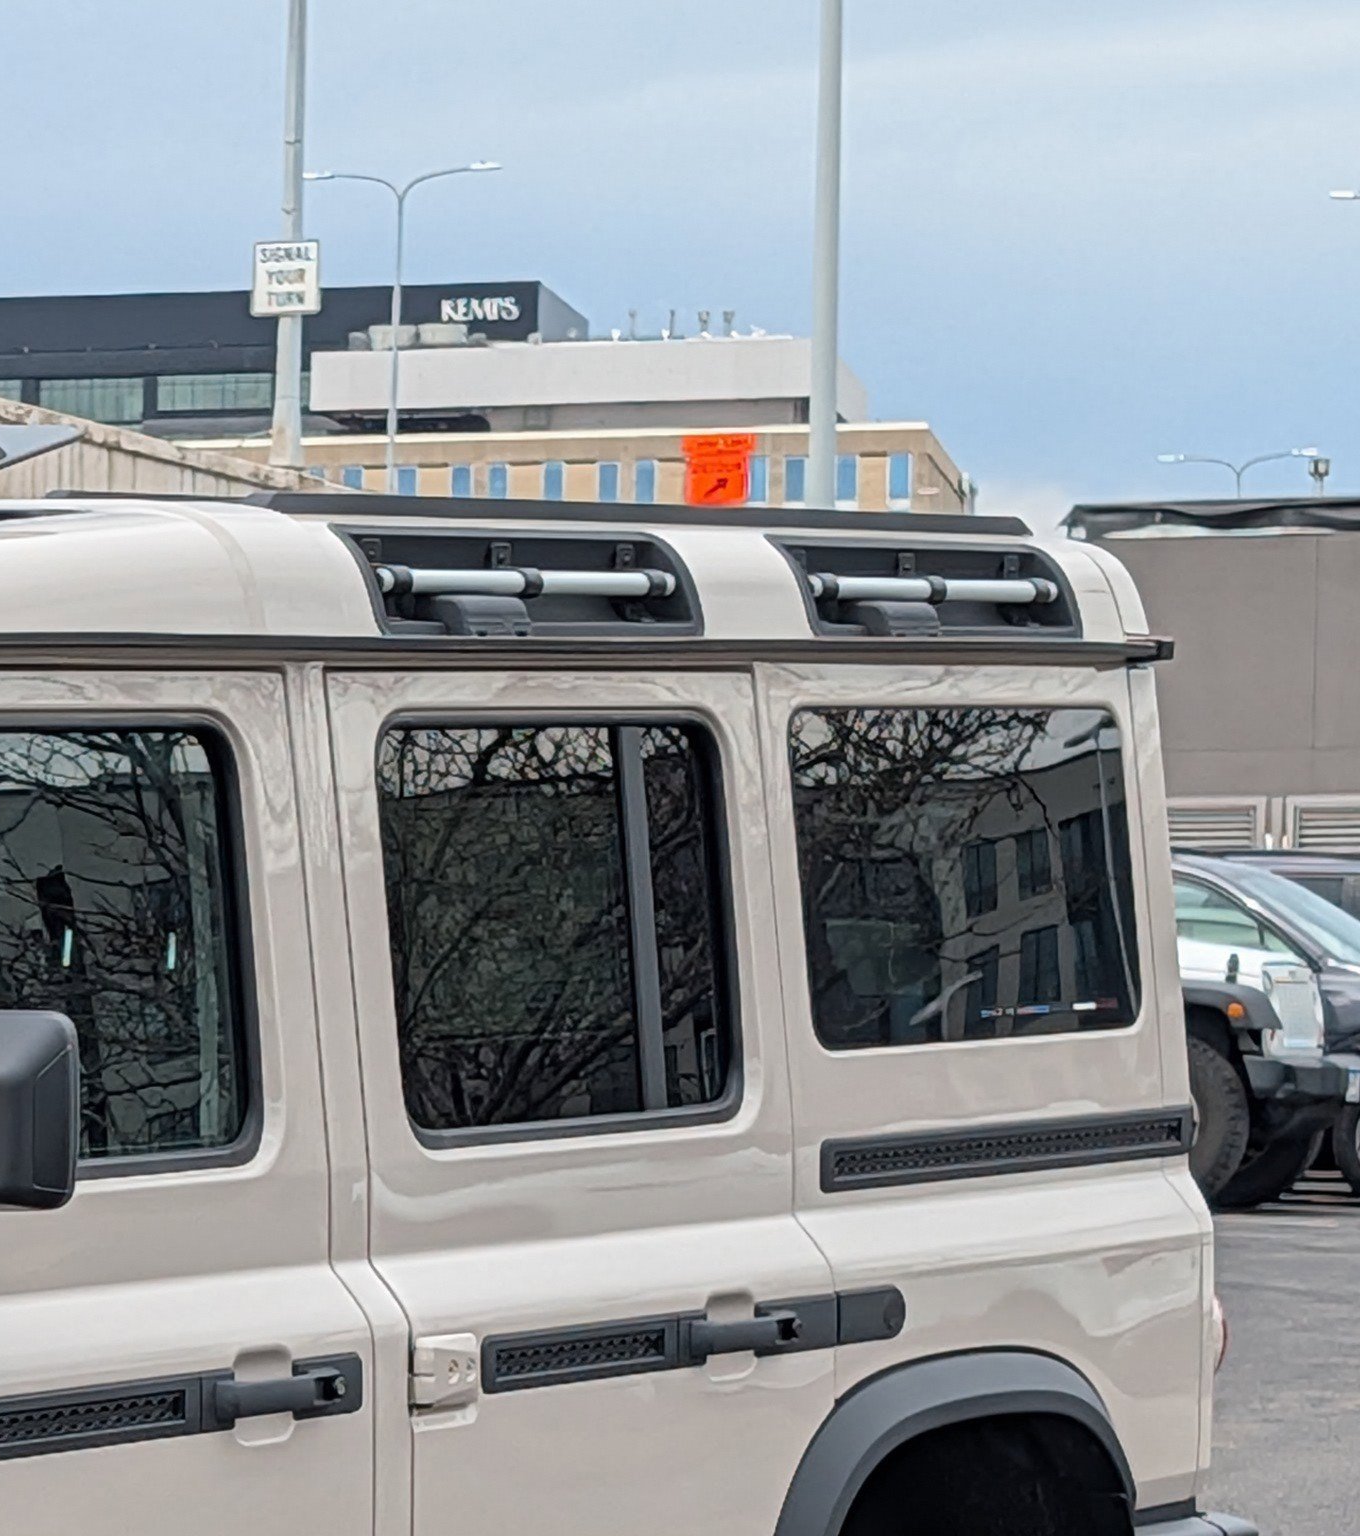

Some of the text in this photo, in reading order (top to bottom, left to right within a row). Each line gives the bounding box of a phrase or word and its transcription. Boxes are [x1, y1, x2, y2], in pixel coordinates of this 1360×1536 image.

[260, 246, 314, 263] SIGNAL
[266, 268, 306, 285] YOUR
[266, 291, 306, 307] TURN
[440, 296, 520, 321] KEMPS
